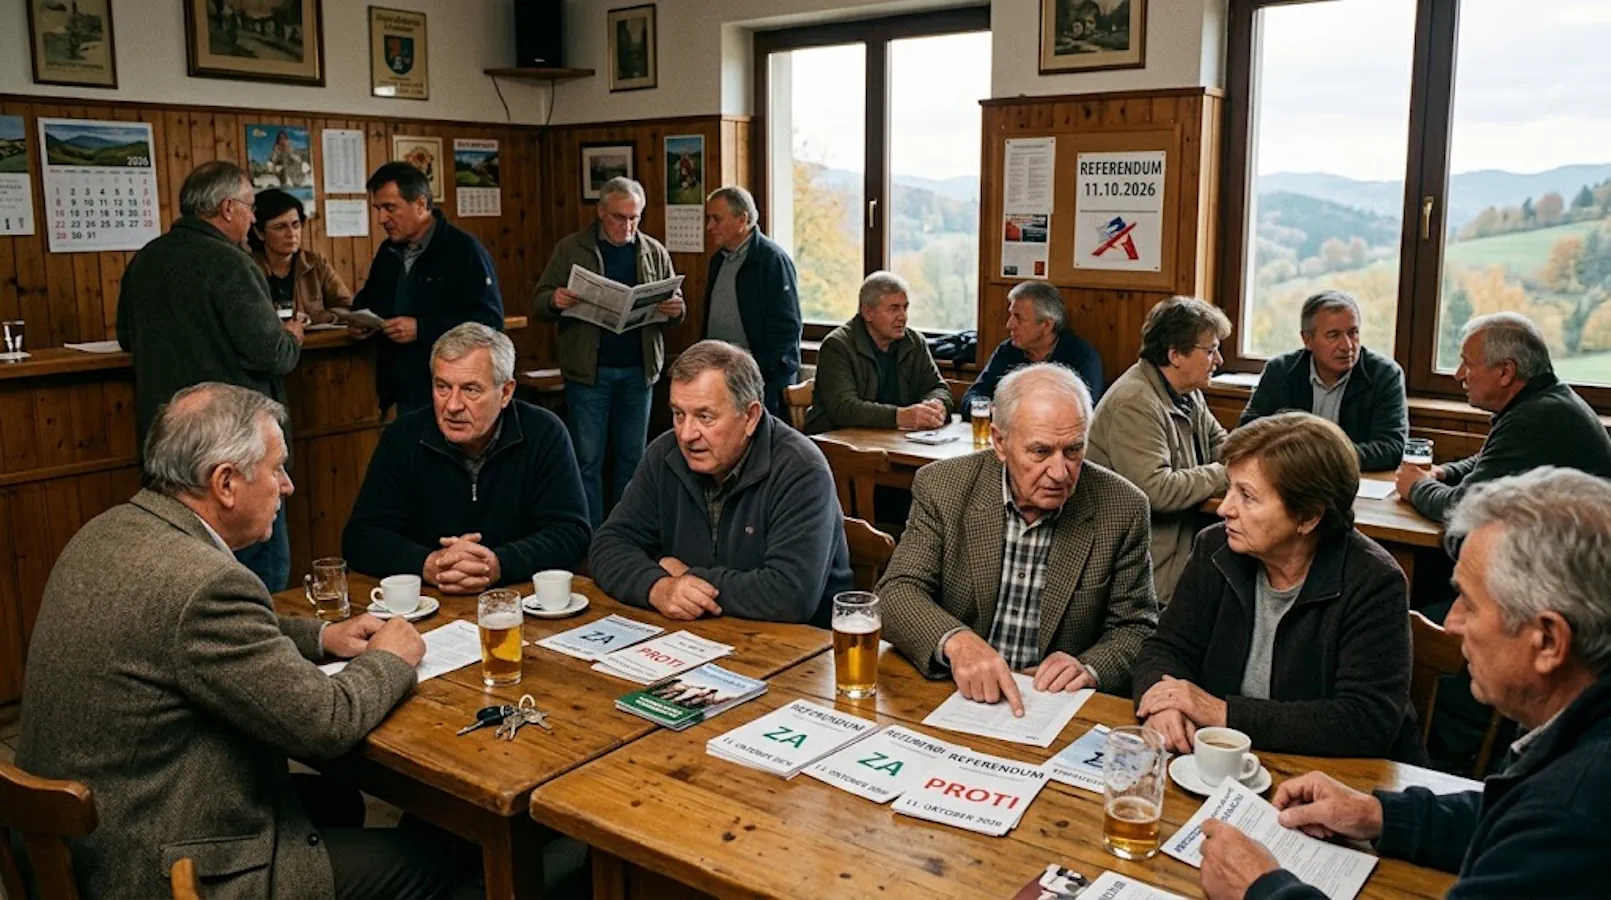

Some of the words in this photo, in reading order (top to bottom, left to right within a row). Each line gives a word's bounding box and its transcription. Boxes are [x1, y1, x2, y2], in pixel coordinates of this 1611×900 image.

[1080, 160, 1162, 175] REFERENDUM
[1085, 182, 1156, 196] 11.10.2026
[579, 631, 615, 644] ZA
[636, 647, 686, 668] PROTI
[763, 726, 808, 748] ZA
[857, 752, 904, 776] ZA
[924, 778, 1020, 809] PROTI
